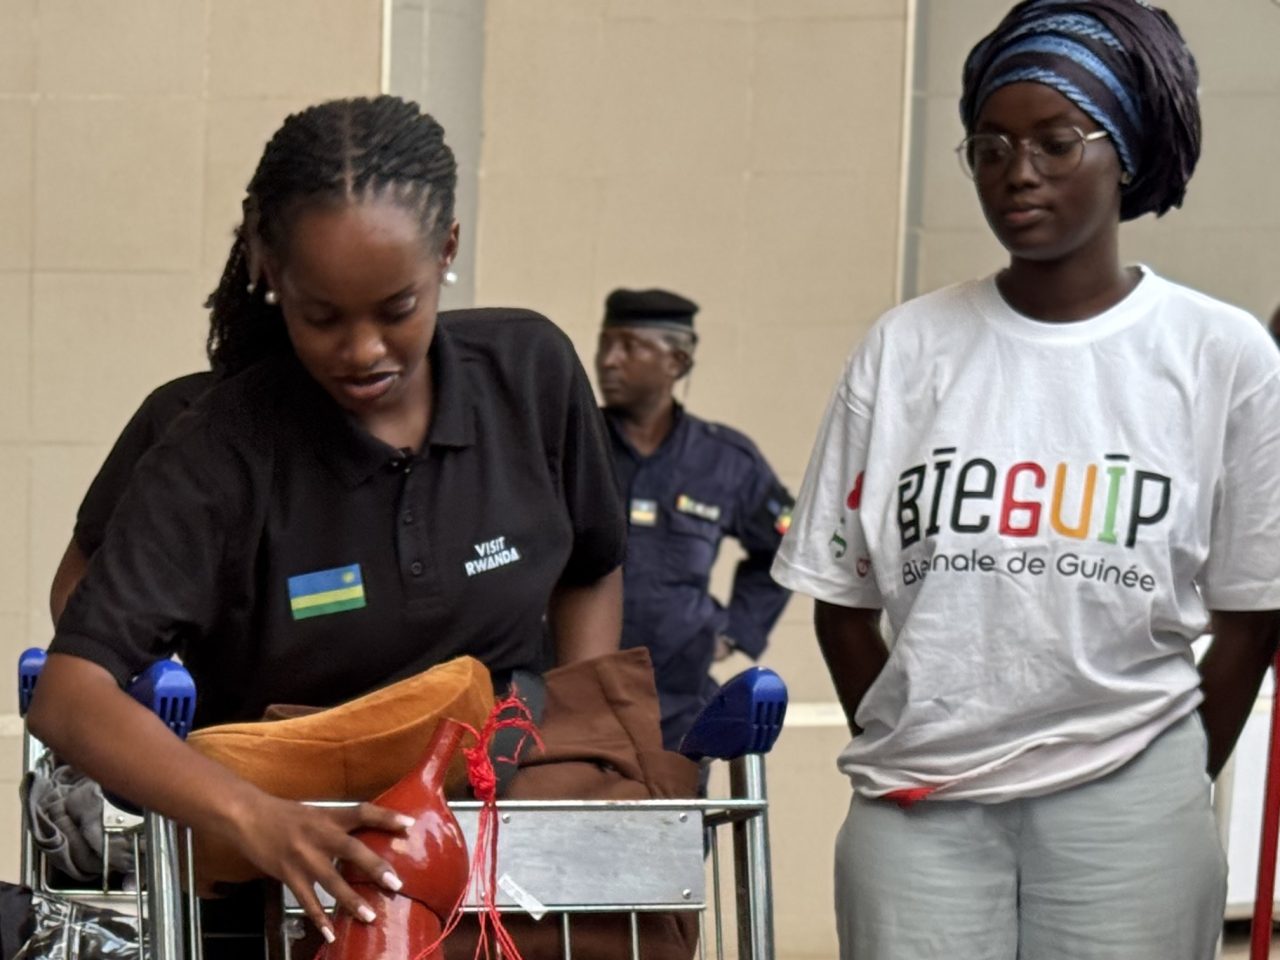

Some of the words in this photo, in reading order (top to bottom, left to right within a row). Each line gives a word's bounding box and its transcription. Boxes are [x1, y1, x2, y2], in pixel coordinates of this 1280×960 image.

[474, 536, 505, 557] VISIT
[464, 547, 520, 576] RWANDA
[1006, 550, 1046, 576] de
[1056, 552, 1157, 593] Guinée
